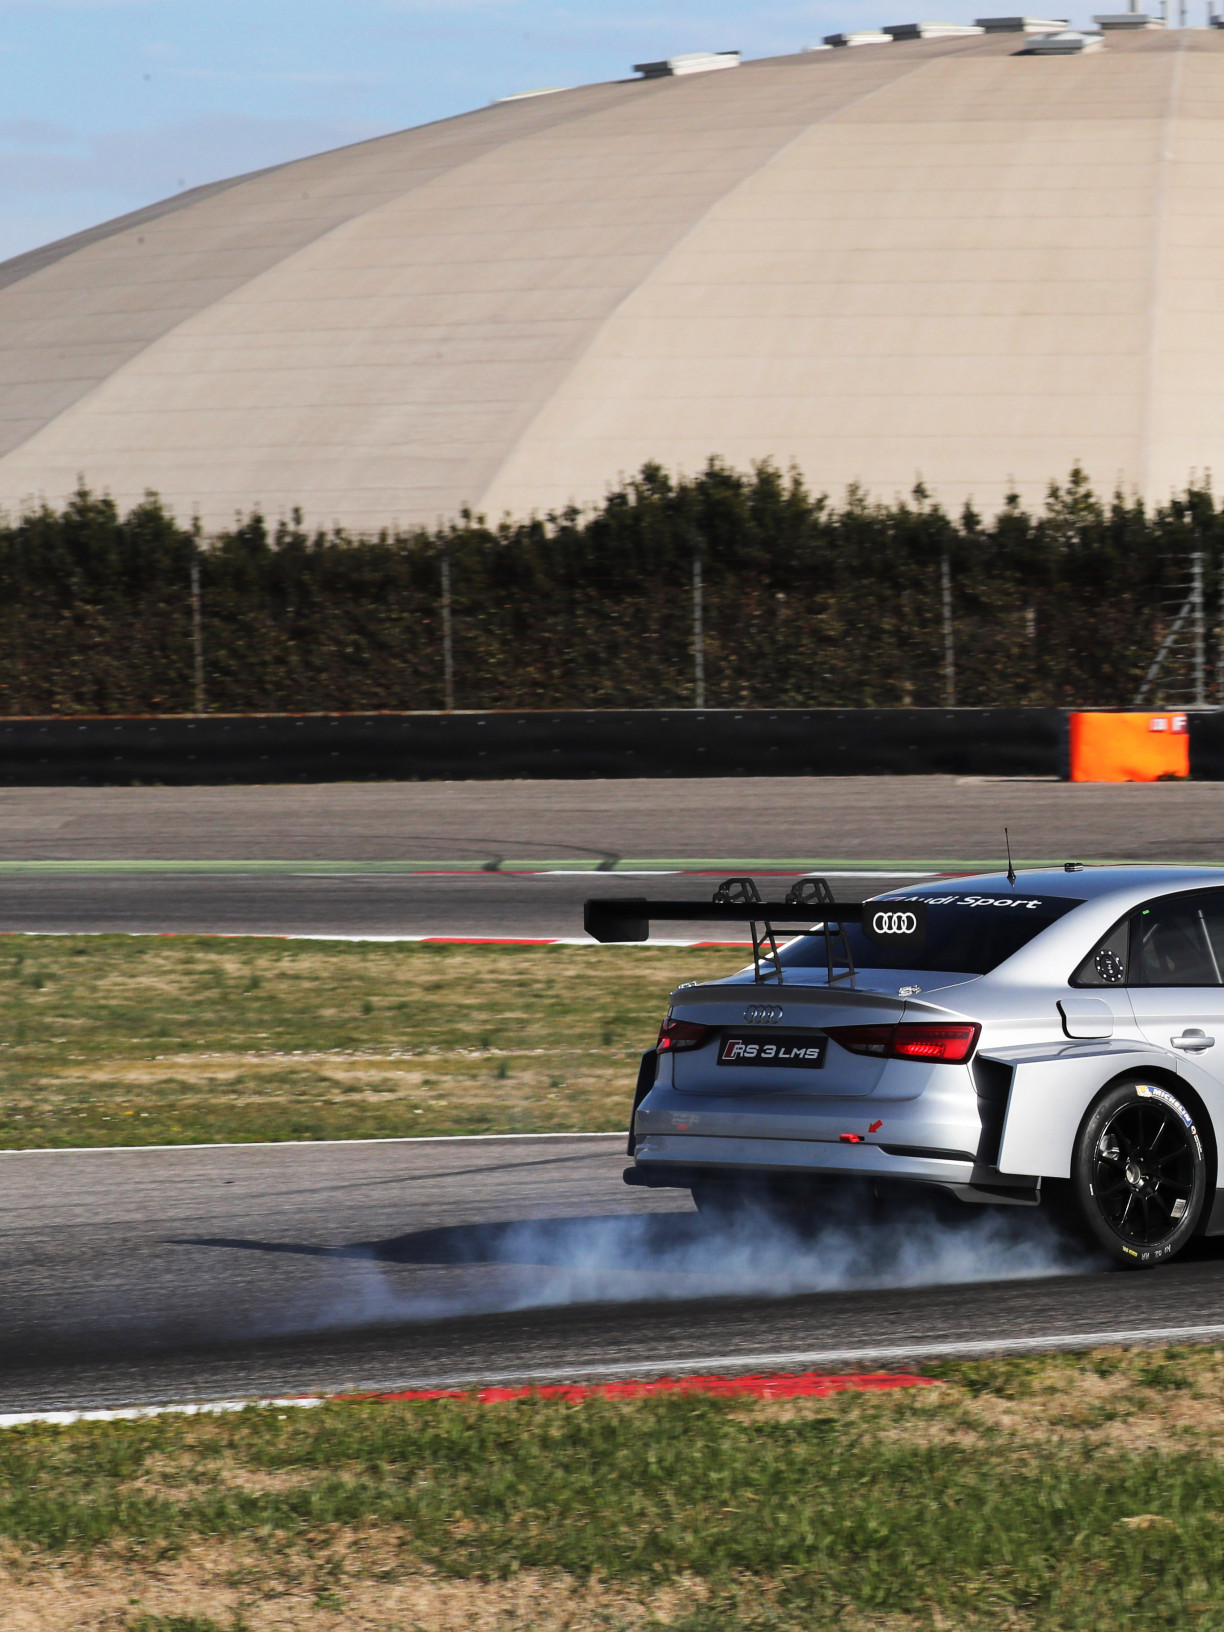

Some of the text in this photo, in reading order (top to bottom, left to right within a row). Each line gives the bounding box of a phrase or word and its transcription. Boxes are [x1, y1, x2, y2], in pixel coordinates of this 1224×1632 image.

[957, 895, 1043, 909] Sport
[728, 1043, 820, 1059] RS 3 LMS
[1152, 1088, 1192, 1122] MICHELIN
